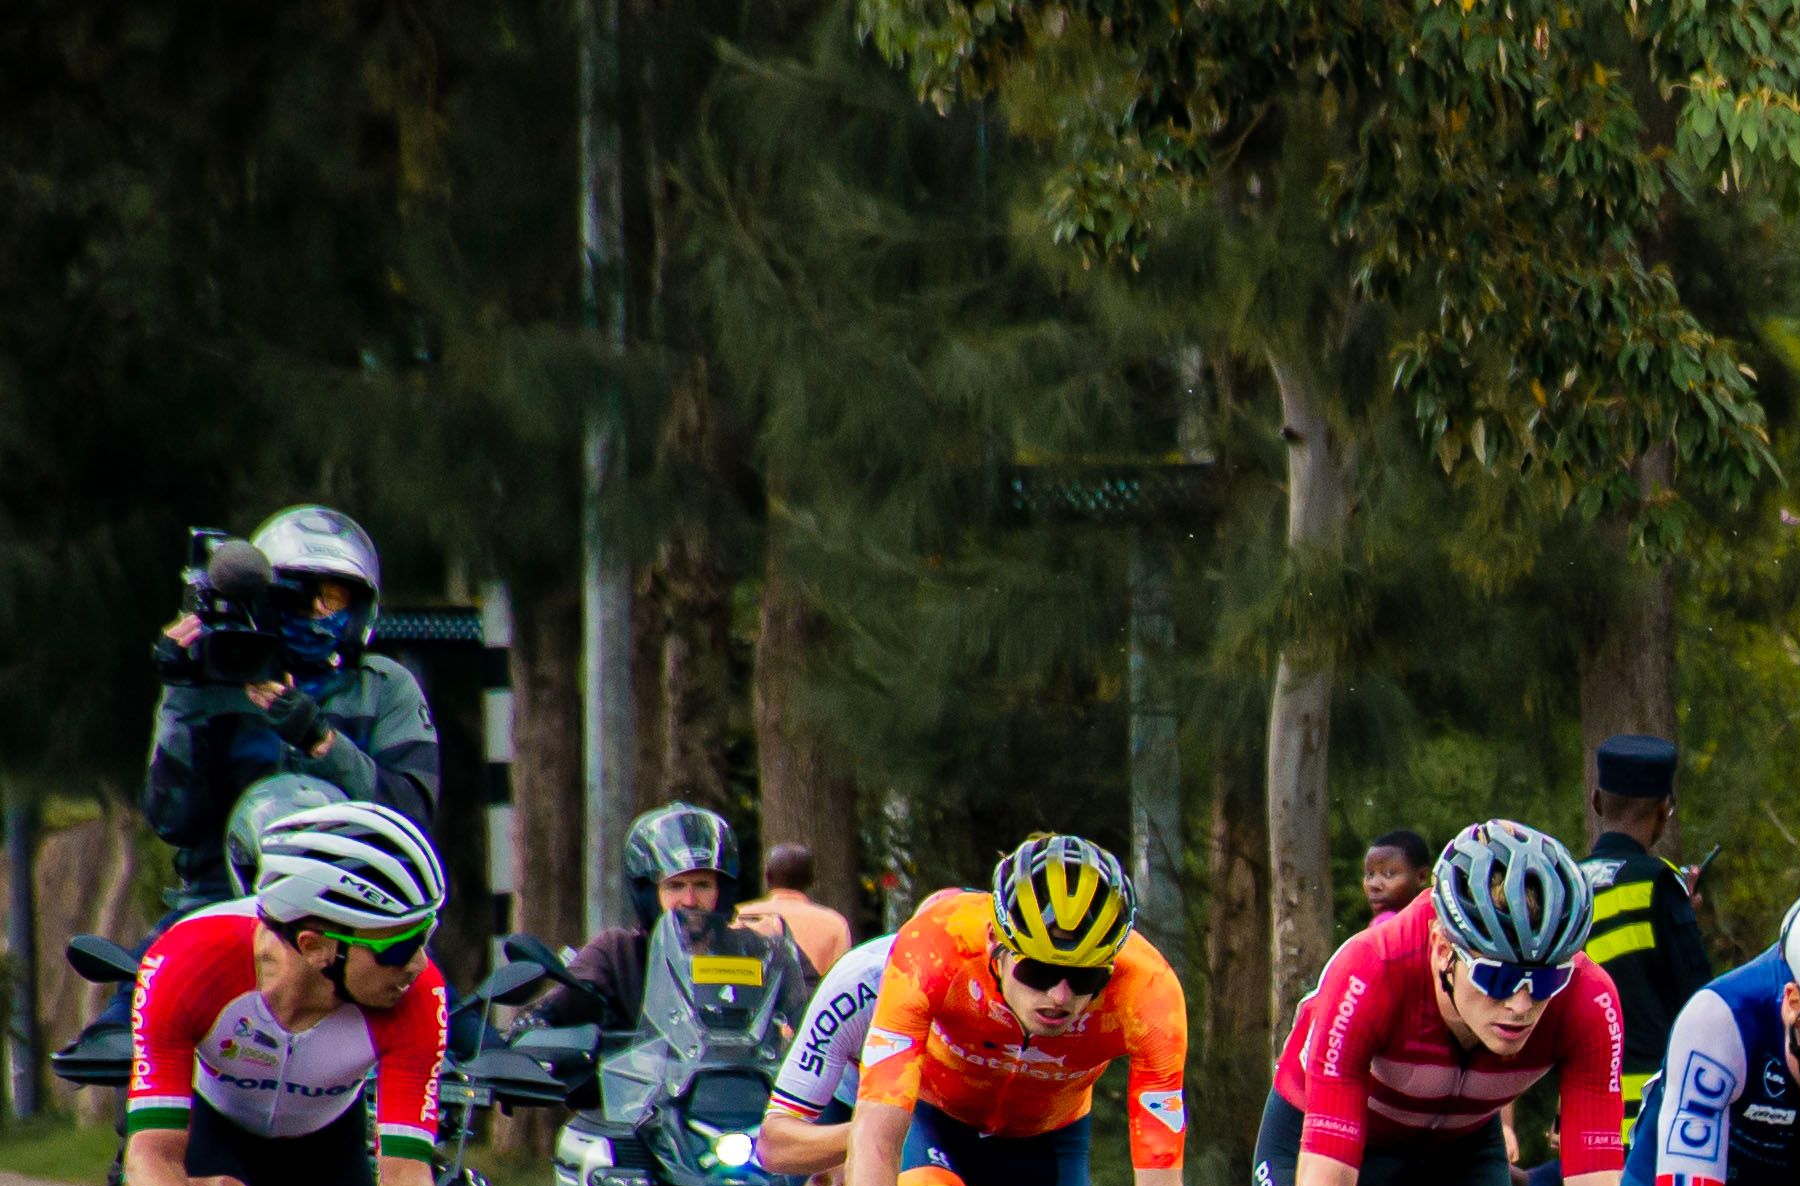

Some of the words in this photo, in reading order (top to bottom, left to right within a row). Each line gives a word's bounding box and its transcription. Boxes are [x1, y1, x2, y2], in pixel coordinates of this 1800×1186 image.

[339, 874, 396, 905] MET
[133, 953, 165, 1093] PORTUGAL
[417, 985, 448, 1123] PORTUGAL
[1317, 975, 1367, 1077] postnord
[1593, 992, 1622, 1093] postnord
[1680, 1066, 1727, 1149] CIC
